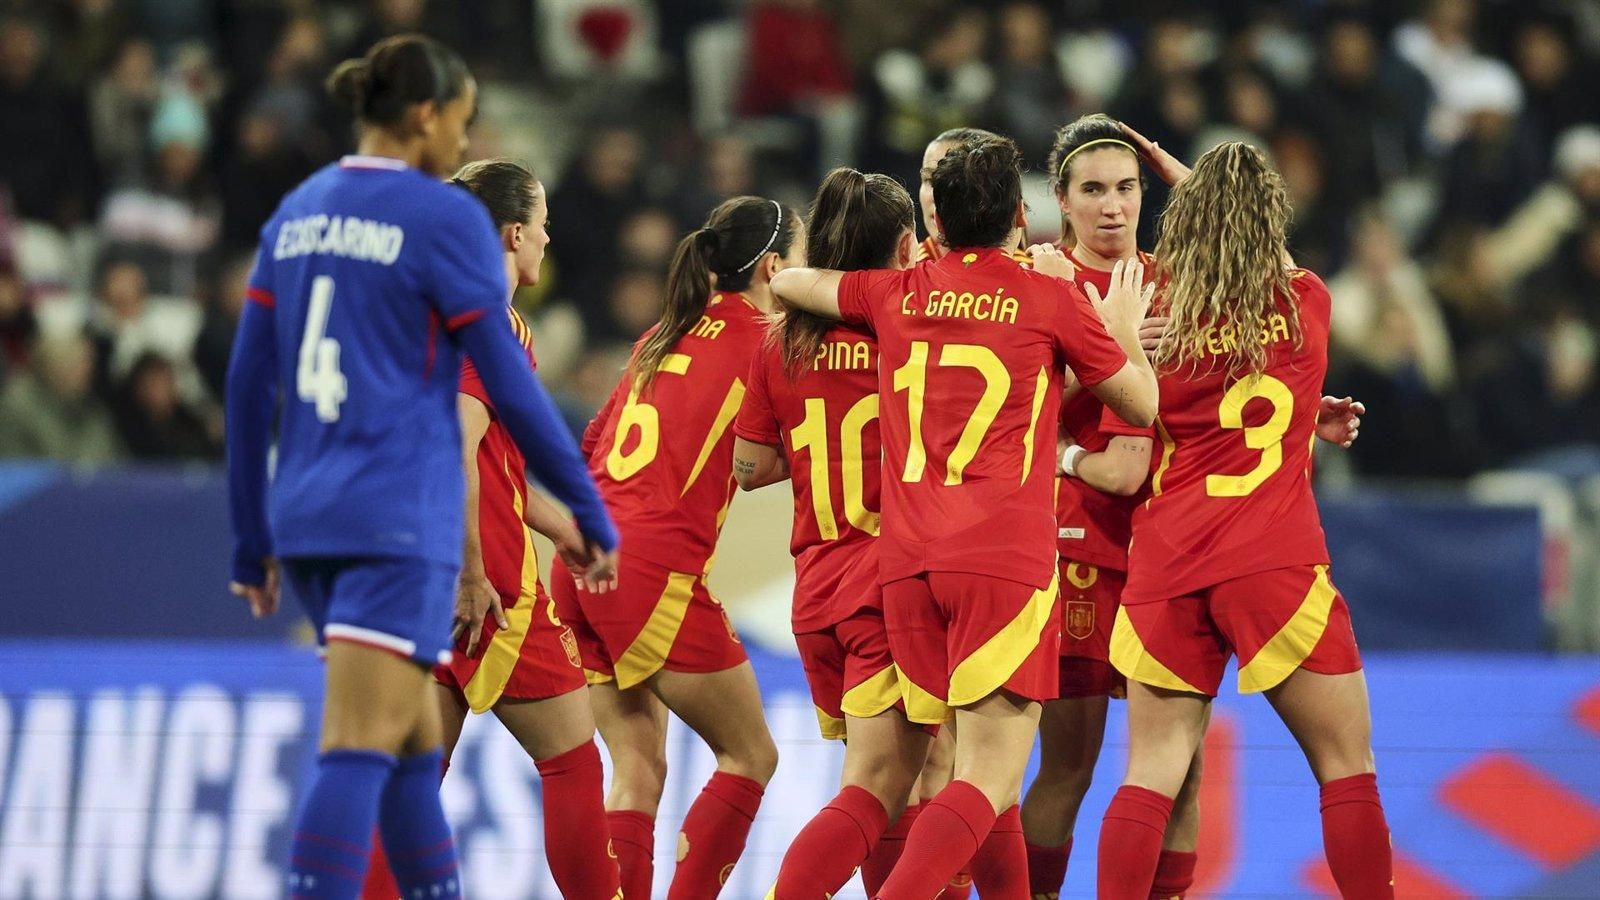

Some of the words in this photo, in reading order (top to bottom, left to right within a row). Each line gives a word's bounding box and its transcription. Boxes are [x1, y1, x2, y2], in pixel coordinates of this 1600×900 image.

[296, 274, 348, 424] 4
[813, 341, 869, 371] PINA
[924, 287, 1019, 324] GARCÍA
[606, 353, 692, 482] 6
[894, 341, 1011, 486] 17
[1206, 373, 1294, 497] 3
[0, 684, 304, 900] ANCE
